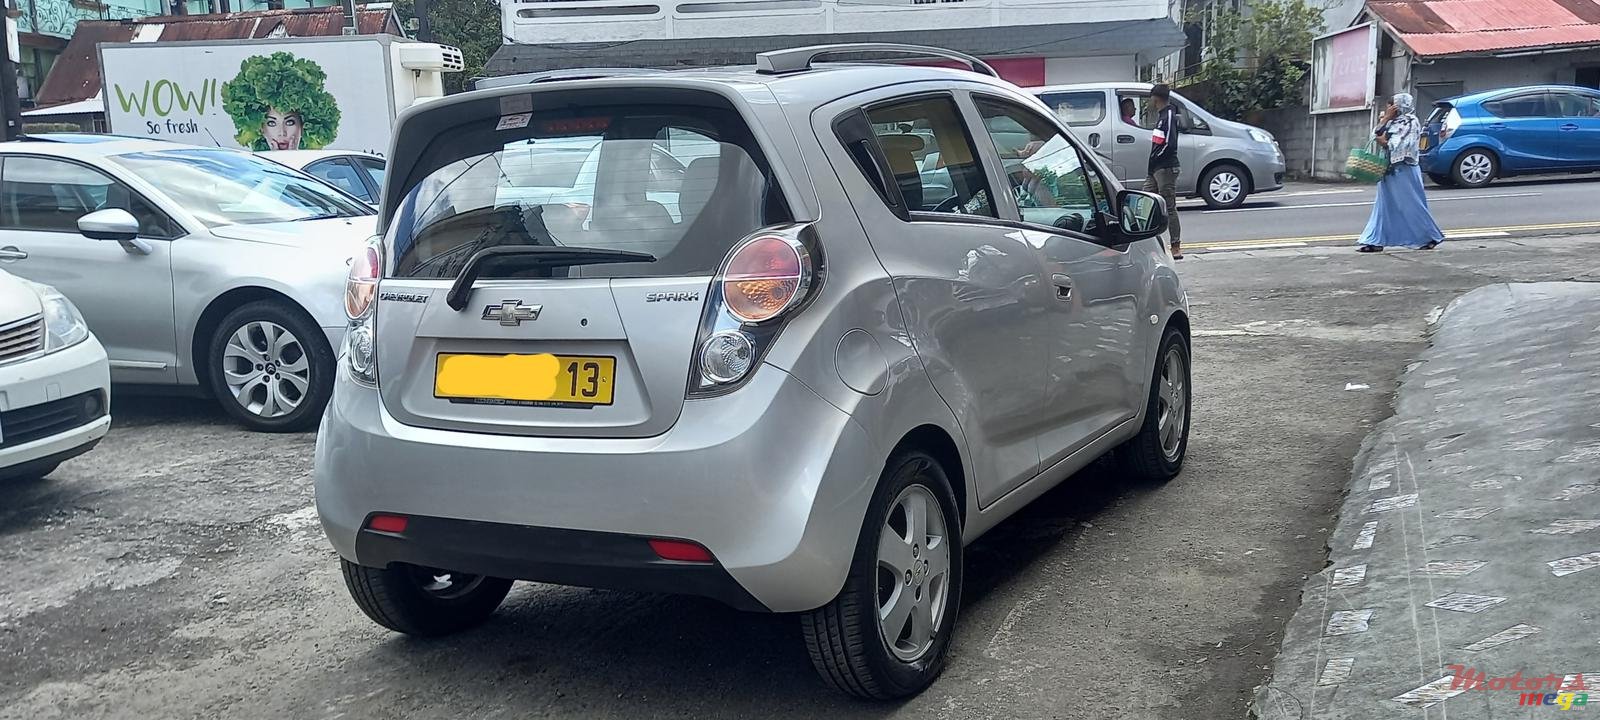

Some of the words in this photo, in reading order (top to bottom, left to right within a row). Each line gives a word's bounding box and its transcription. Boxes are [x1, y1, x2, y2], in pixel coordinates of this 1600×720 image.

[114, 78, 216, 117] WOW!
[146, 120, 161, 135] So
[165, 118, 199, 135] fresh
[646, 291, 699, 303] SPARK
[567, 361, 600, 397] 13
